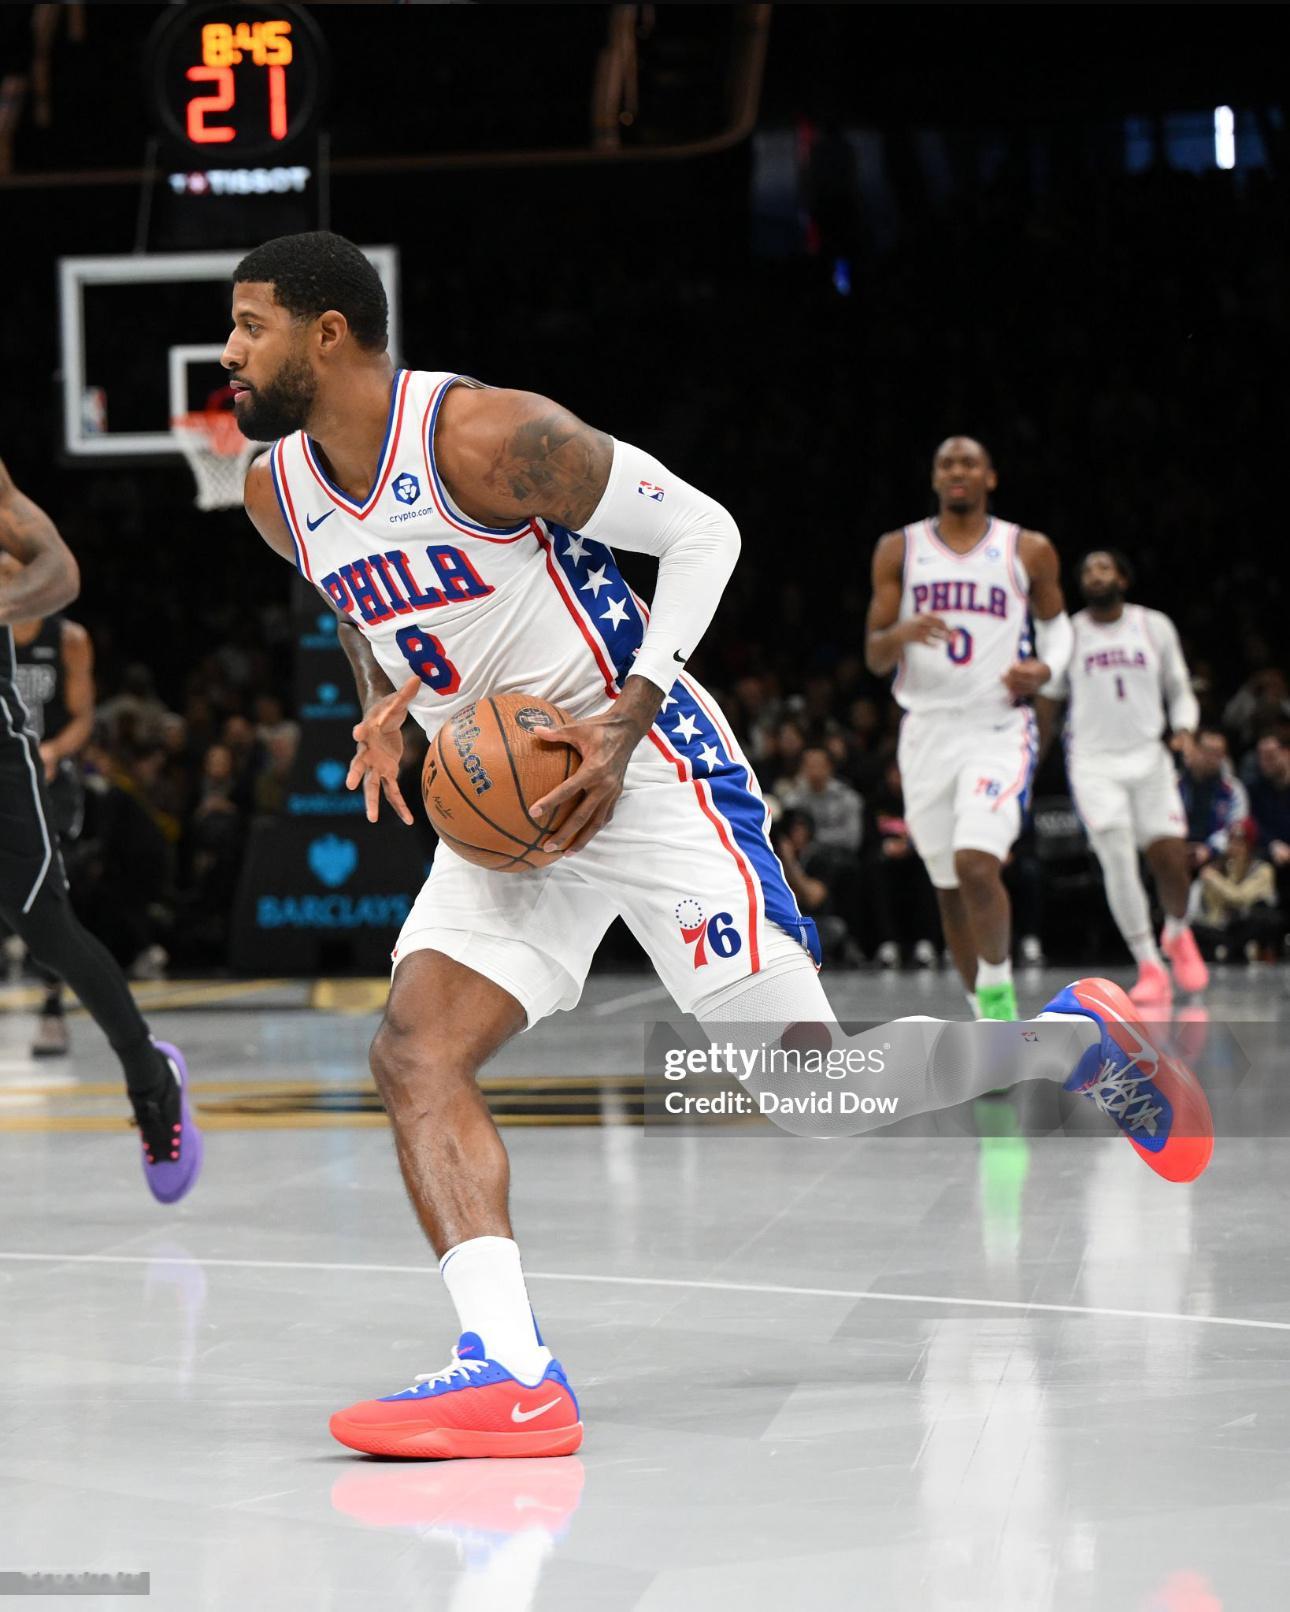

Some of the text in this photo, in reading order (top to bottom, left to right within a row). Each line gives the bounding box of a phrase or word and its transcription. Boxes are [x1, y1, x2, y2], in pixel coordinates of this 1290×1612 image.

[186, 65, 288, 144] 21
[389, 506, 433, 523] crypto.com
[320, 545, 496, 625] PHILA
[913, 581, 1008, 619] PHILA
[395, 624, 462, 696] 8
[947, 626, 974, 666] 0
[1084, 649, 1148, 675] PHILA
[1114, 674, 1127, 700] 1
[680, 911, 742, 970] 76
